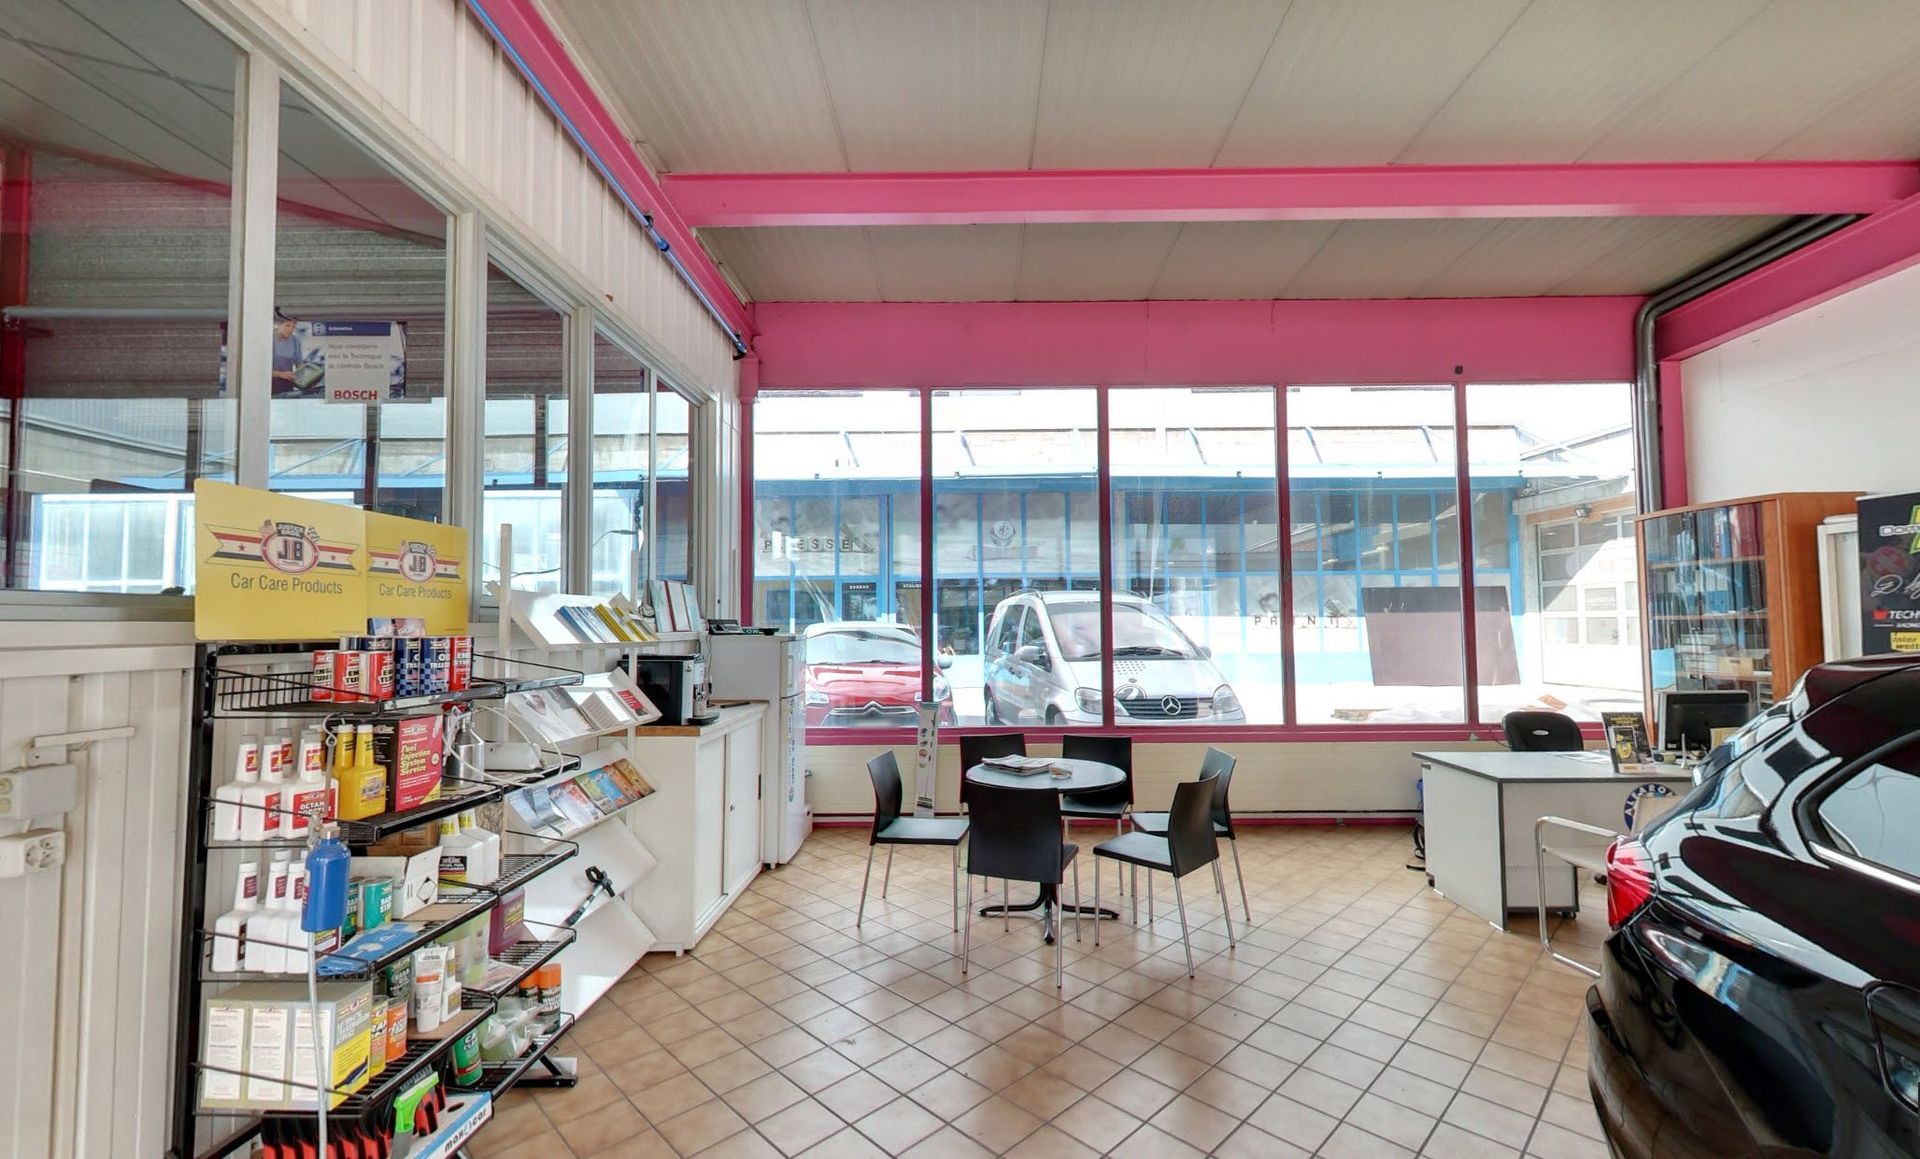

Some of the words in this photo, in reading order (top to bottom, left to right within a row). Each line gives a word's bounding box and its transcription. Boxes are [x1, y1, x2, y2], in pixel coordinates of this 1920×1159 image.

[334, 389, 378, 400] BOSCH
[764, 539, 850, 551] PESSE
[230, 572, 252, 590] Car
[259, 574, 288, 592] Care
[292, 577, 343, 594] Products
[379, 583, 395, 597] Car
[397, 584, 416, 598] Care
[418, 586, 452, 599] Products
[1255, 616, 1334, 626] PRNT
[401, 743, 417, 754] Fuel
[400, 750, 431, 762] Injection
[400, 758, 426, 769] System
[400, 765, 427, 776] Service
